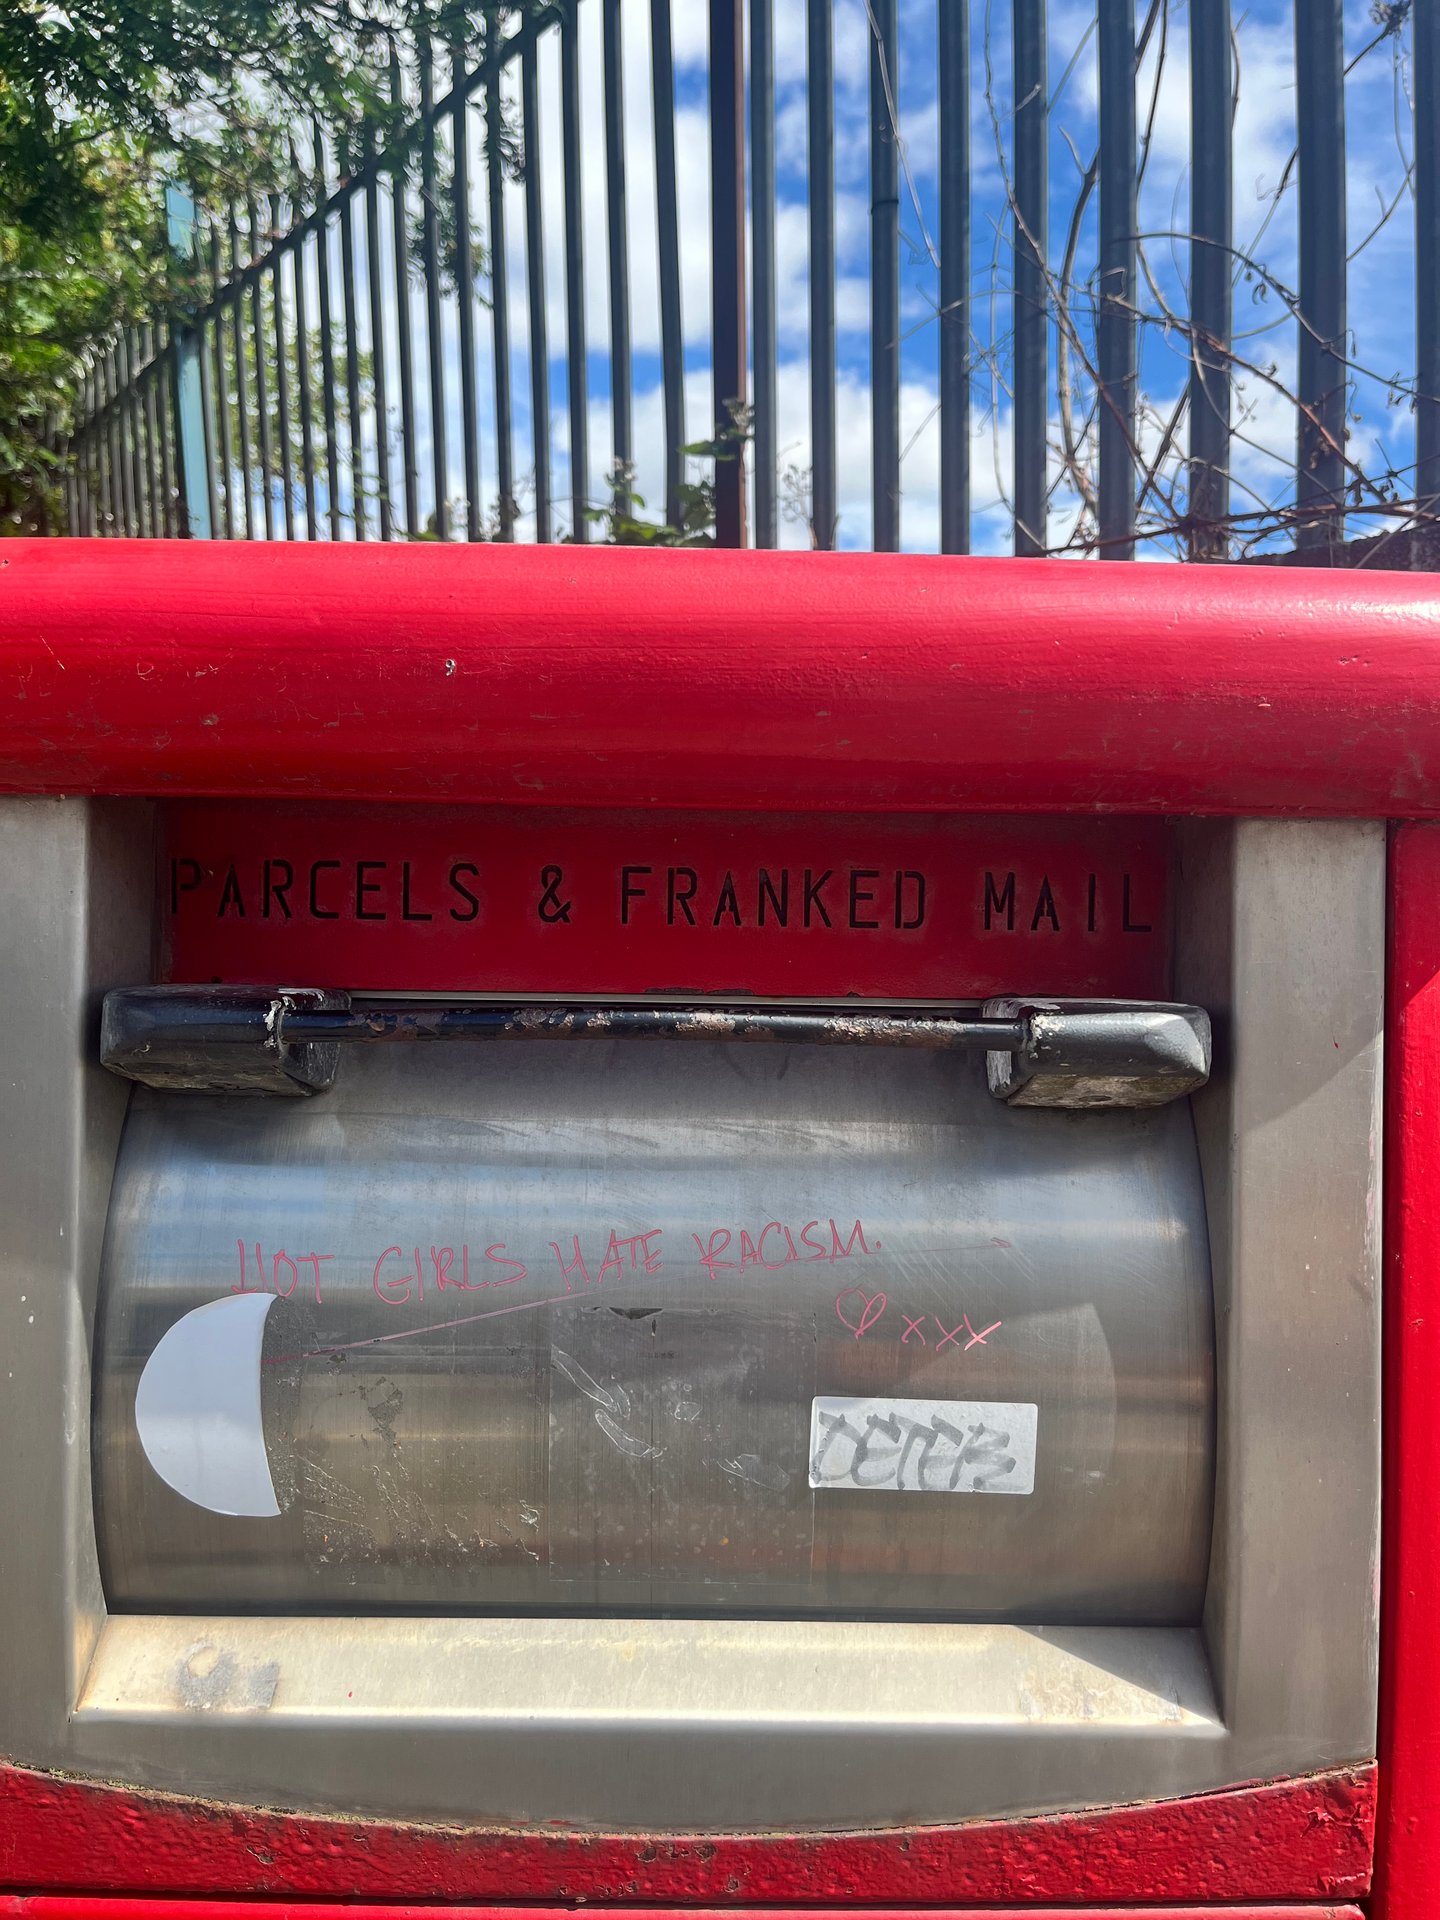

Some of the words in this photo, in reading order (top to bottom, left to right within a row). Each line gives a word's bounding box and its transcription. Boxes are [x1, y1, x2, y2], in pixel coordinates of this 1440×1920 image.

[170, 857, 481, 922] PARCELS
[537, 864, 571, 924] &
[620, 866, 926, 929] FRANKED
[984, 870, 1153, 933] MAIL
[373, 1243, 528, 1304] GIRLS
[549, 1228, 664, 1290] HATE
